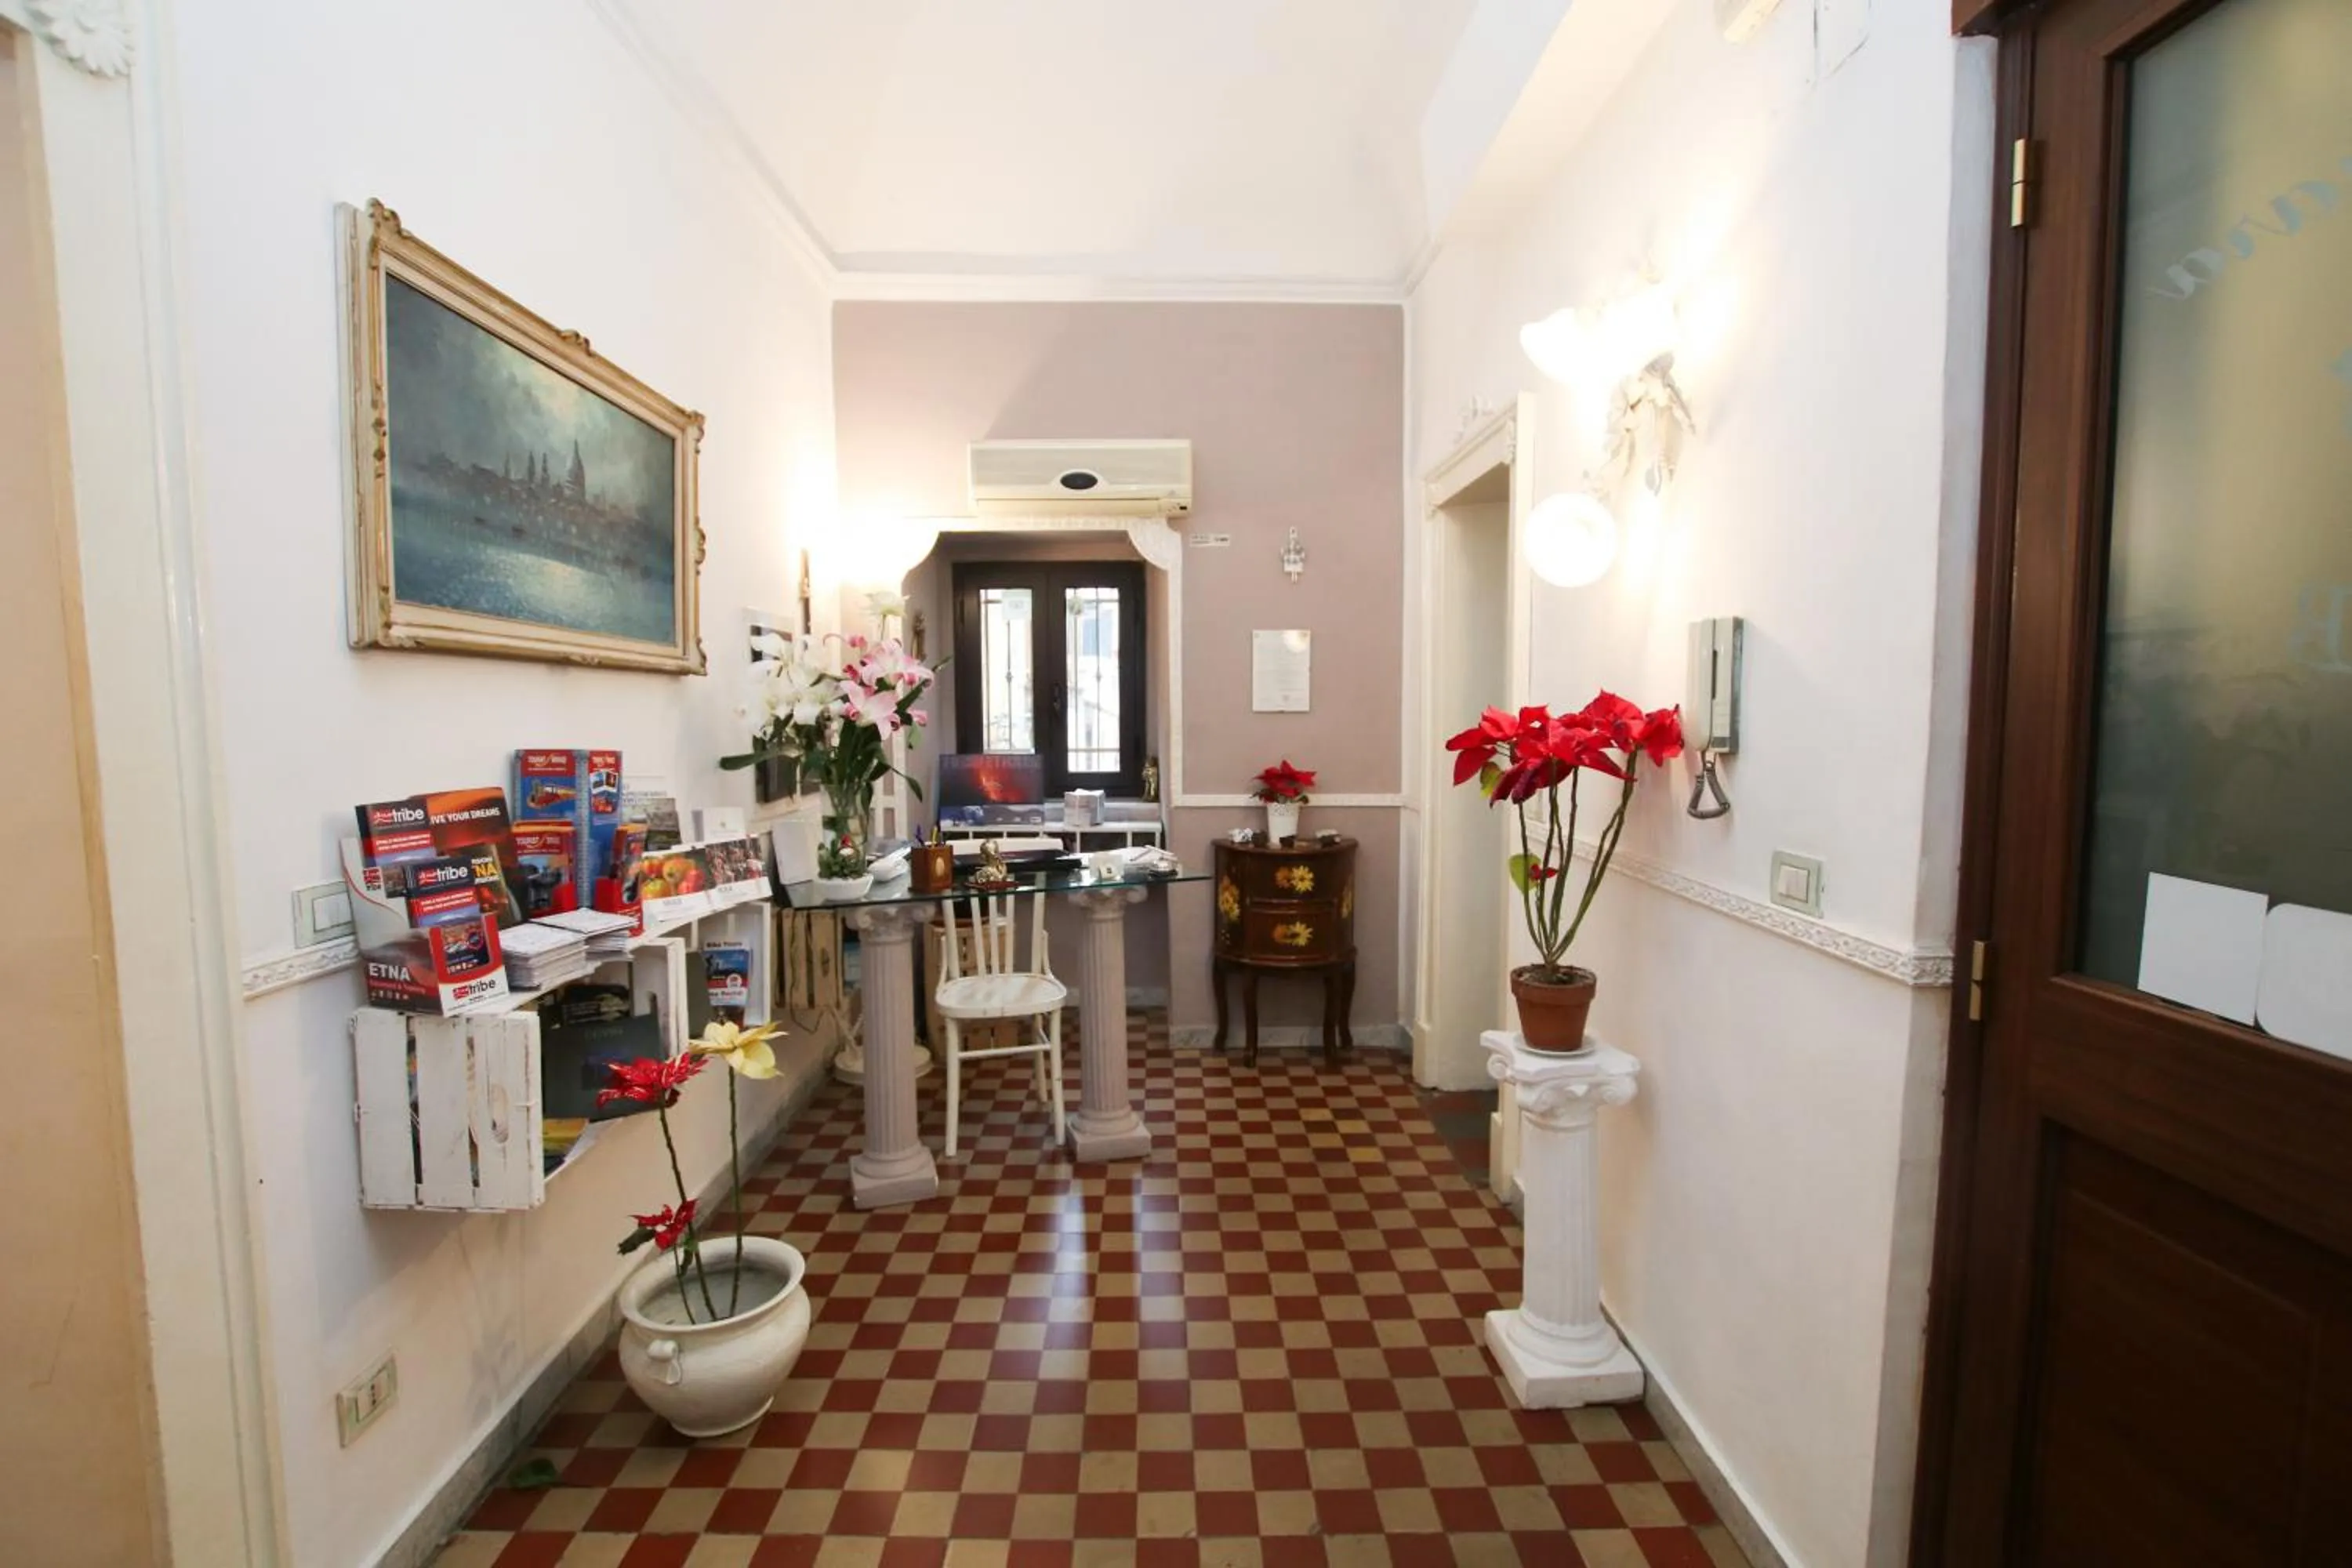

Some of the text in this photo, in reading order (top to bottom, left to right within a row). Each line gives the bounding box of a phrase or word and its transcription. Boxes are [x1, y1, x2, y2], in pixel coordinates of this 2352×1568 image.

[430, 807, 501, 825] IVE YOUR DREAMS
[368, 963, 411, 982] ETNA
